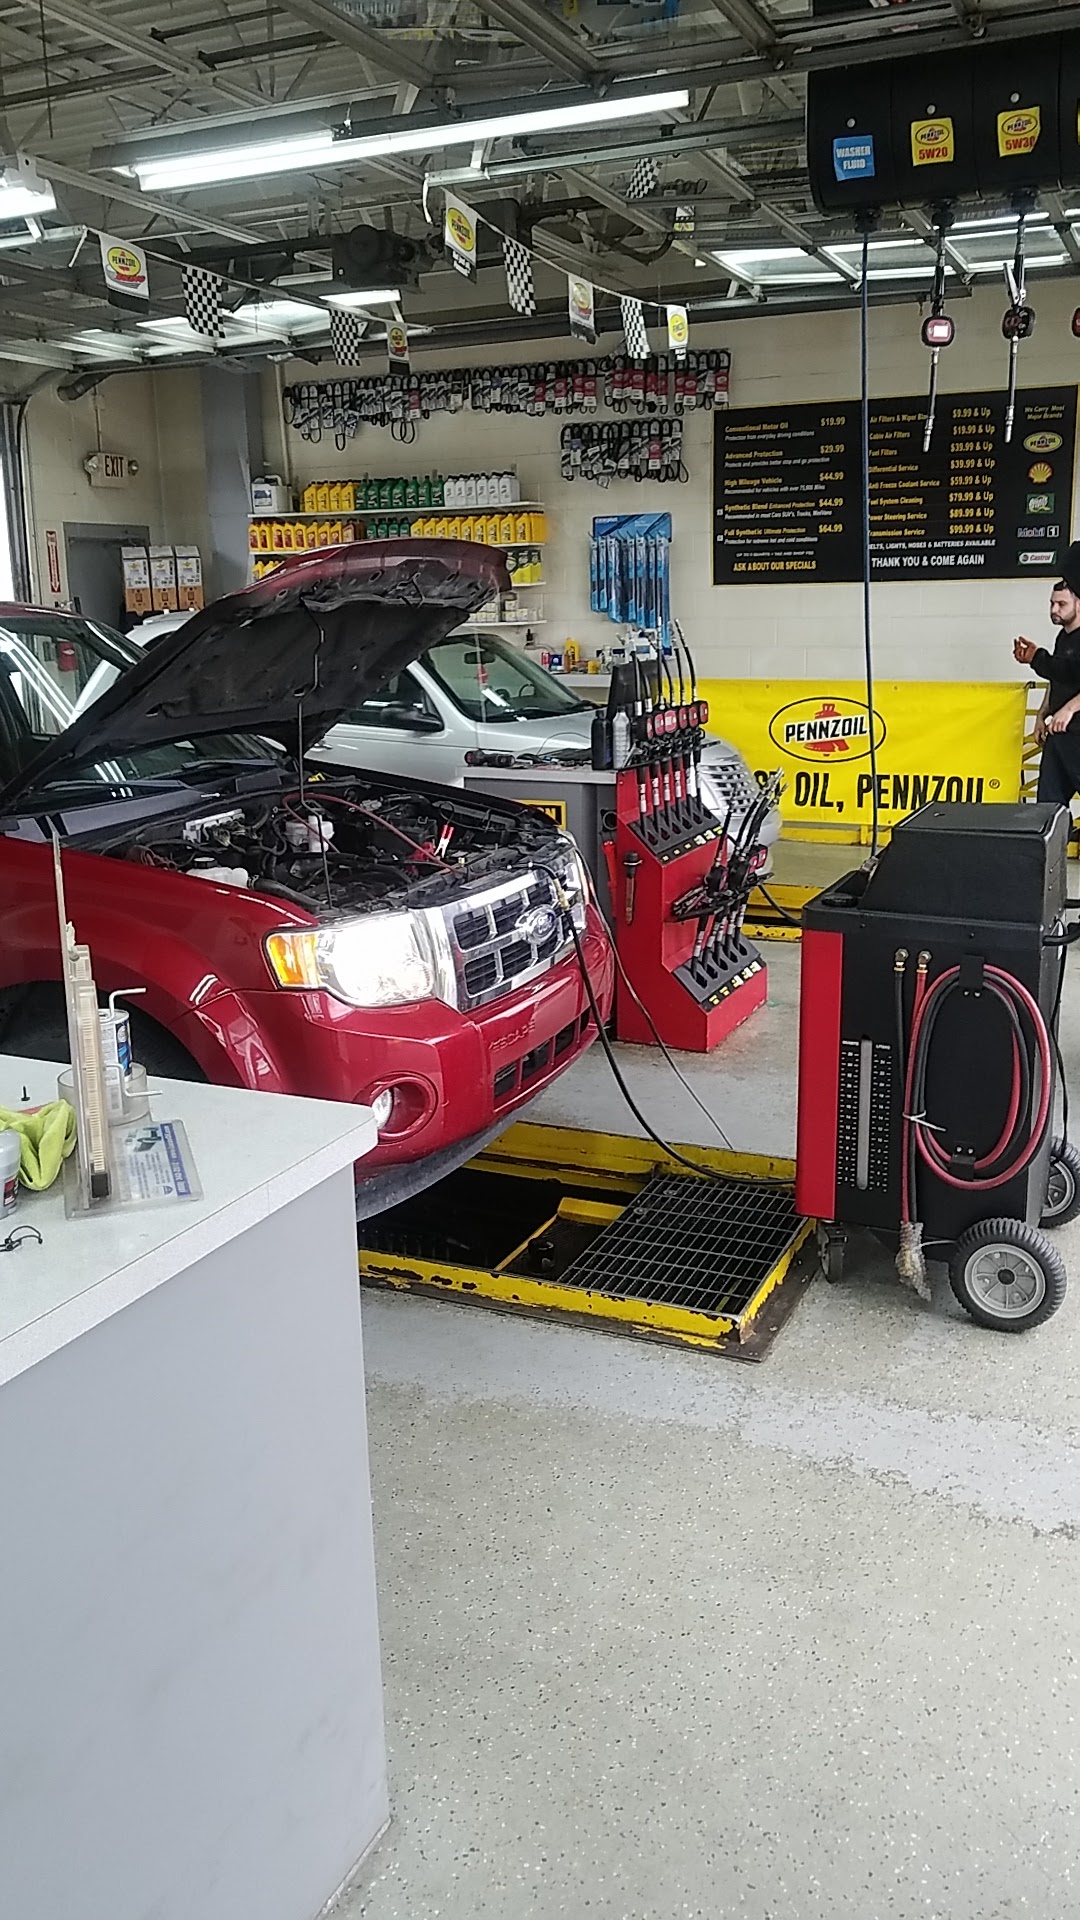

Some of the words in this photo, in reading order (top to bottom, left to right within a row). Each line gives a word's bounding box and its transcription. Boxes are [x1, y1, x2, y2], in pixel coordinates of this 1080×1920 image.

[1005, 136, 1035, 150] 5W30
[836, 146, 870, 158] WASHER
[919, 147, 948, 160] 5W20
[843, 159, 865, 169] FLUID
[902, 414, 916, 422] Wiper
[953, 408, 972, 418] $9.99
[974, 408, 978, 416] &
[981, 408, 990, 417] Up
[725, 424, 761, 432] Conventional
[821, 416, 845, 427] $19.99
[953, 425, 976, 435] $19.99
[978, 425, 983, 433] &
[986, 424, 995, 434] Up
[754, 450, 783, 458] Protection
[820, 444, 844, 454] $29.99
[951, 442, 973, 452] $39.99
[976, 442, 981, 450] &
[983, 442, 993, 452] Up
[105, 456, 123, 477] EXIT
[951, 459, 974, 469] $39.99
[977, 459, 982, 467] &
[985, 458, 995, 468] Up
[820, 472, 844, 481] $44.99
[950, 476, 973, 486] $59.99
[975, 476, 980, 484] &
[982, 475, 991, 485] Up
[725, 504, 750, 512] Synthetic
[819, 498, 843, 507] $44.99
[880, 498, 899, 506] System
[949, 492, 973, 502] $79.99
[976, 492, 980, 500] &
[983, 491, 993, 502] Up
[884, 513, 906, 521] Steering
[950, 509, 974, 518] $89.99
[976, 508, 981, 516] &
[984, 508, 994, 518] Up
[736, 529, 762, 537] Synthetic
[819, 524, 842, 533] $64.99
[950, 525, 974, 534] $99.99
[984, 524, 994, 534] Up
[1017, 528, 1045, 538] Mobil
[734, 563, 746, 571] ASK
[748, 562, 770, 570] ABOUT
[771, 562, 784, 570] OUR
[786, 561, 816, 570] SPECIALS
[872, 557, 900, 567] THANK
[902, 556, 919, 566] YOU
[922, 556, 928, 566] &
[931, 555, 955, 566] COME
[957, 554, 984, 565] AGAIN
[786, 717, 867, 742] PENNZOIL
[795, 772, 844, 812] OIL,
[489, 1019, 535, 1052] ESCAPE
